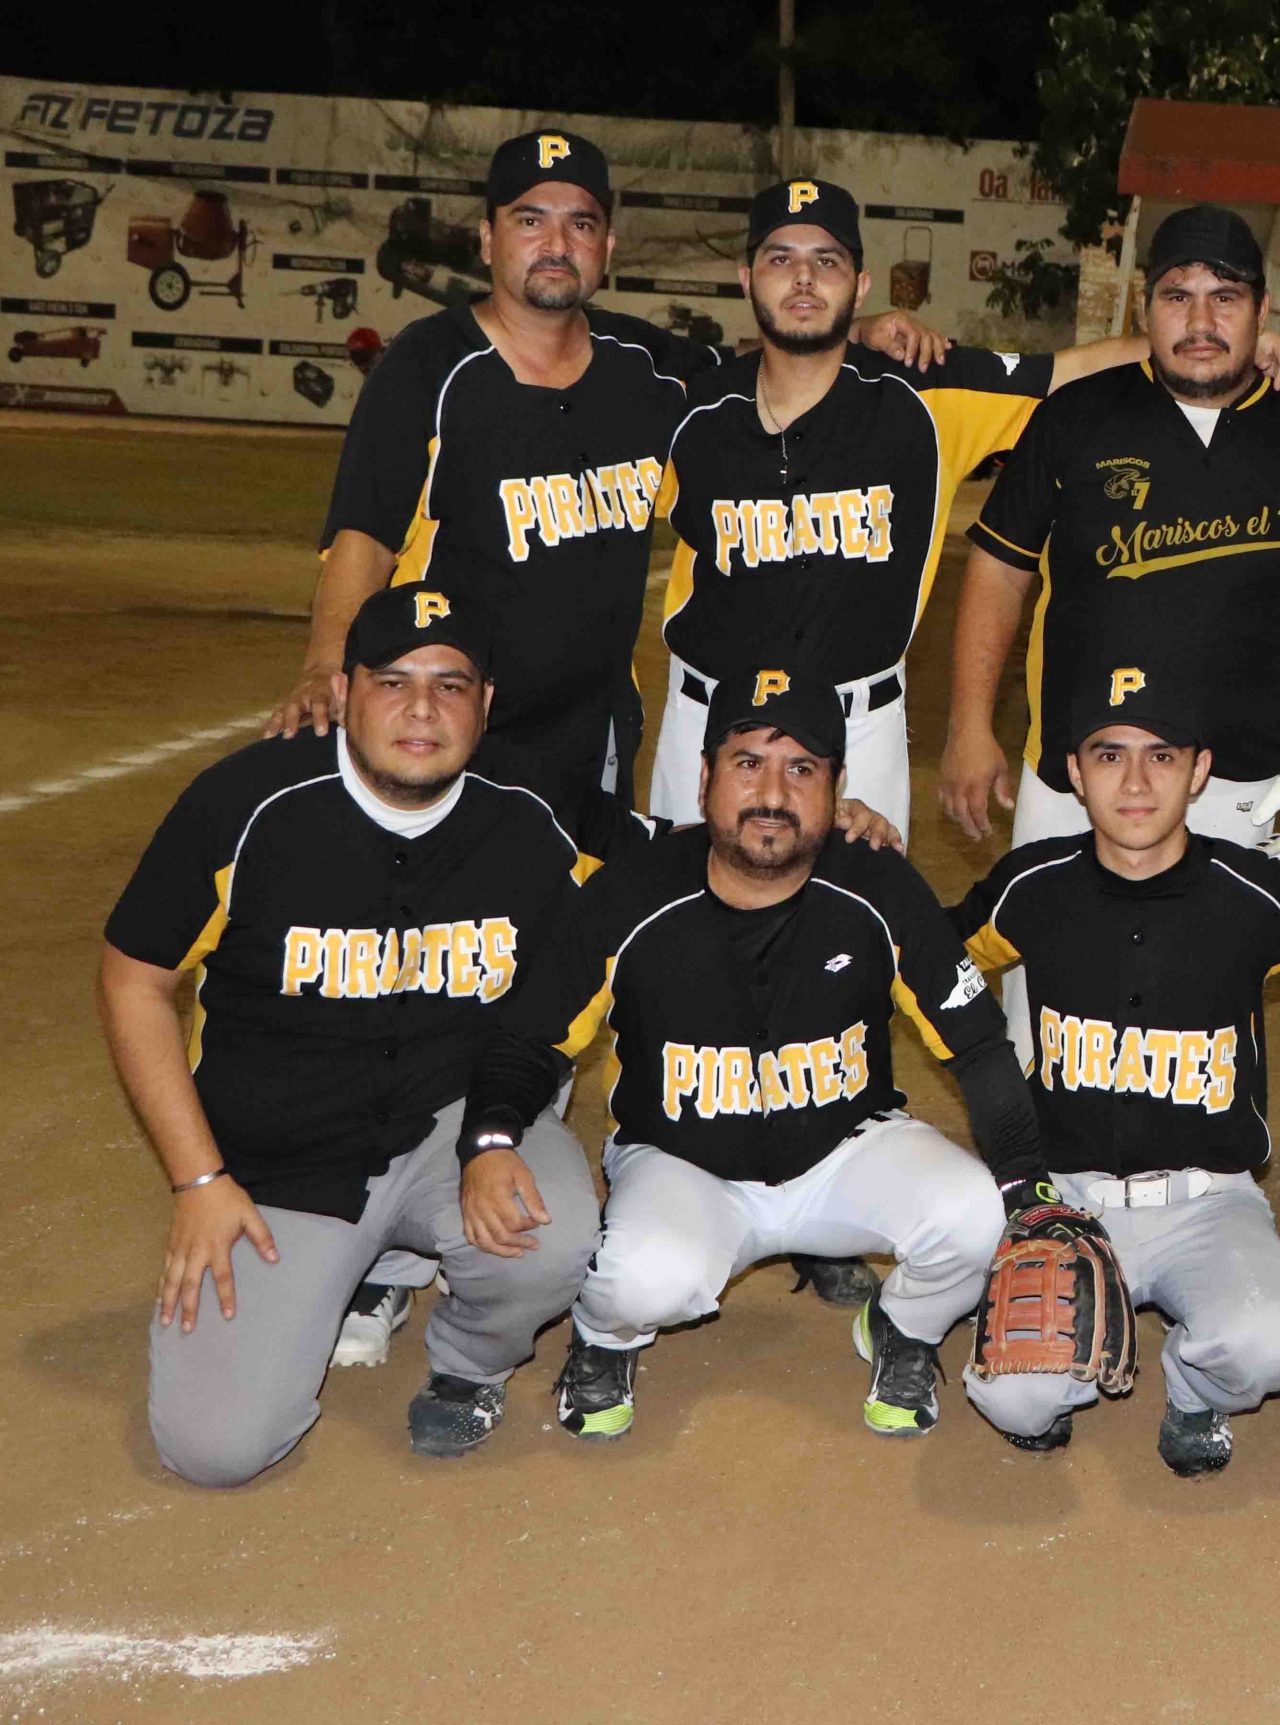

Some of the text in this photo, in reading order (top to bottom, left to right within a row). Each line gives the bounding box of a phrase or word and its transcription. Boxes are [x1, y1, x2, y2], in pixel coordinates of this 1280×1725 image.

[540, 135, 572, 169] P
[788, 181, 820, 213] P
[1095, 456, 1151, 470] MARISCOS
[712, 484, 894, 577] PIRATES
[1095, 514, 1240, 568] Mariscos
[1246, 505, 1271, 536] el
[414, 591, 451, 629] P
[752, 669, 791, 707] P
[1109, 667, 1147, 706] P
[281, 916, 518, 1004] PIRATES
[662, 1019, 870, 1121] PIRATES
[1040, 1005, 1239, 1114] PIRATES
